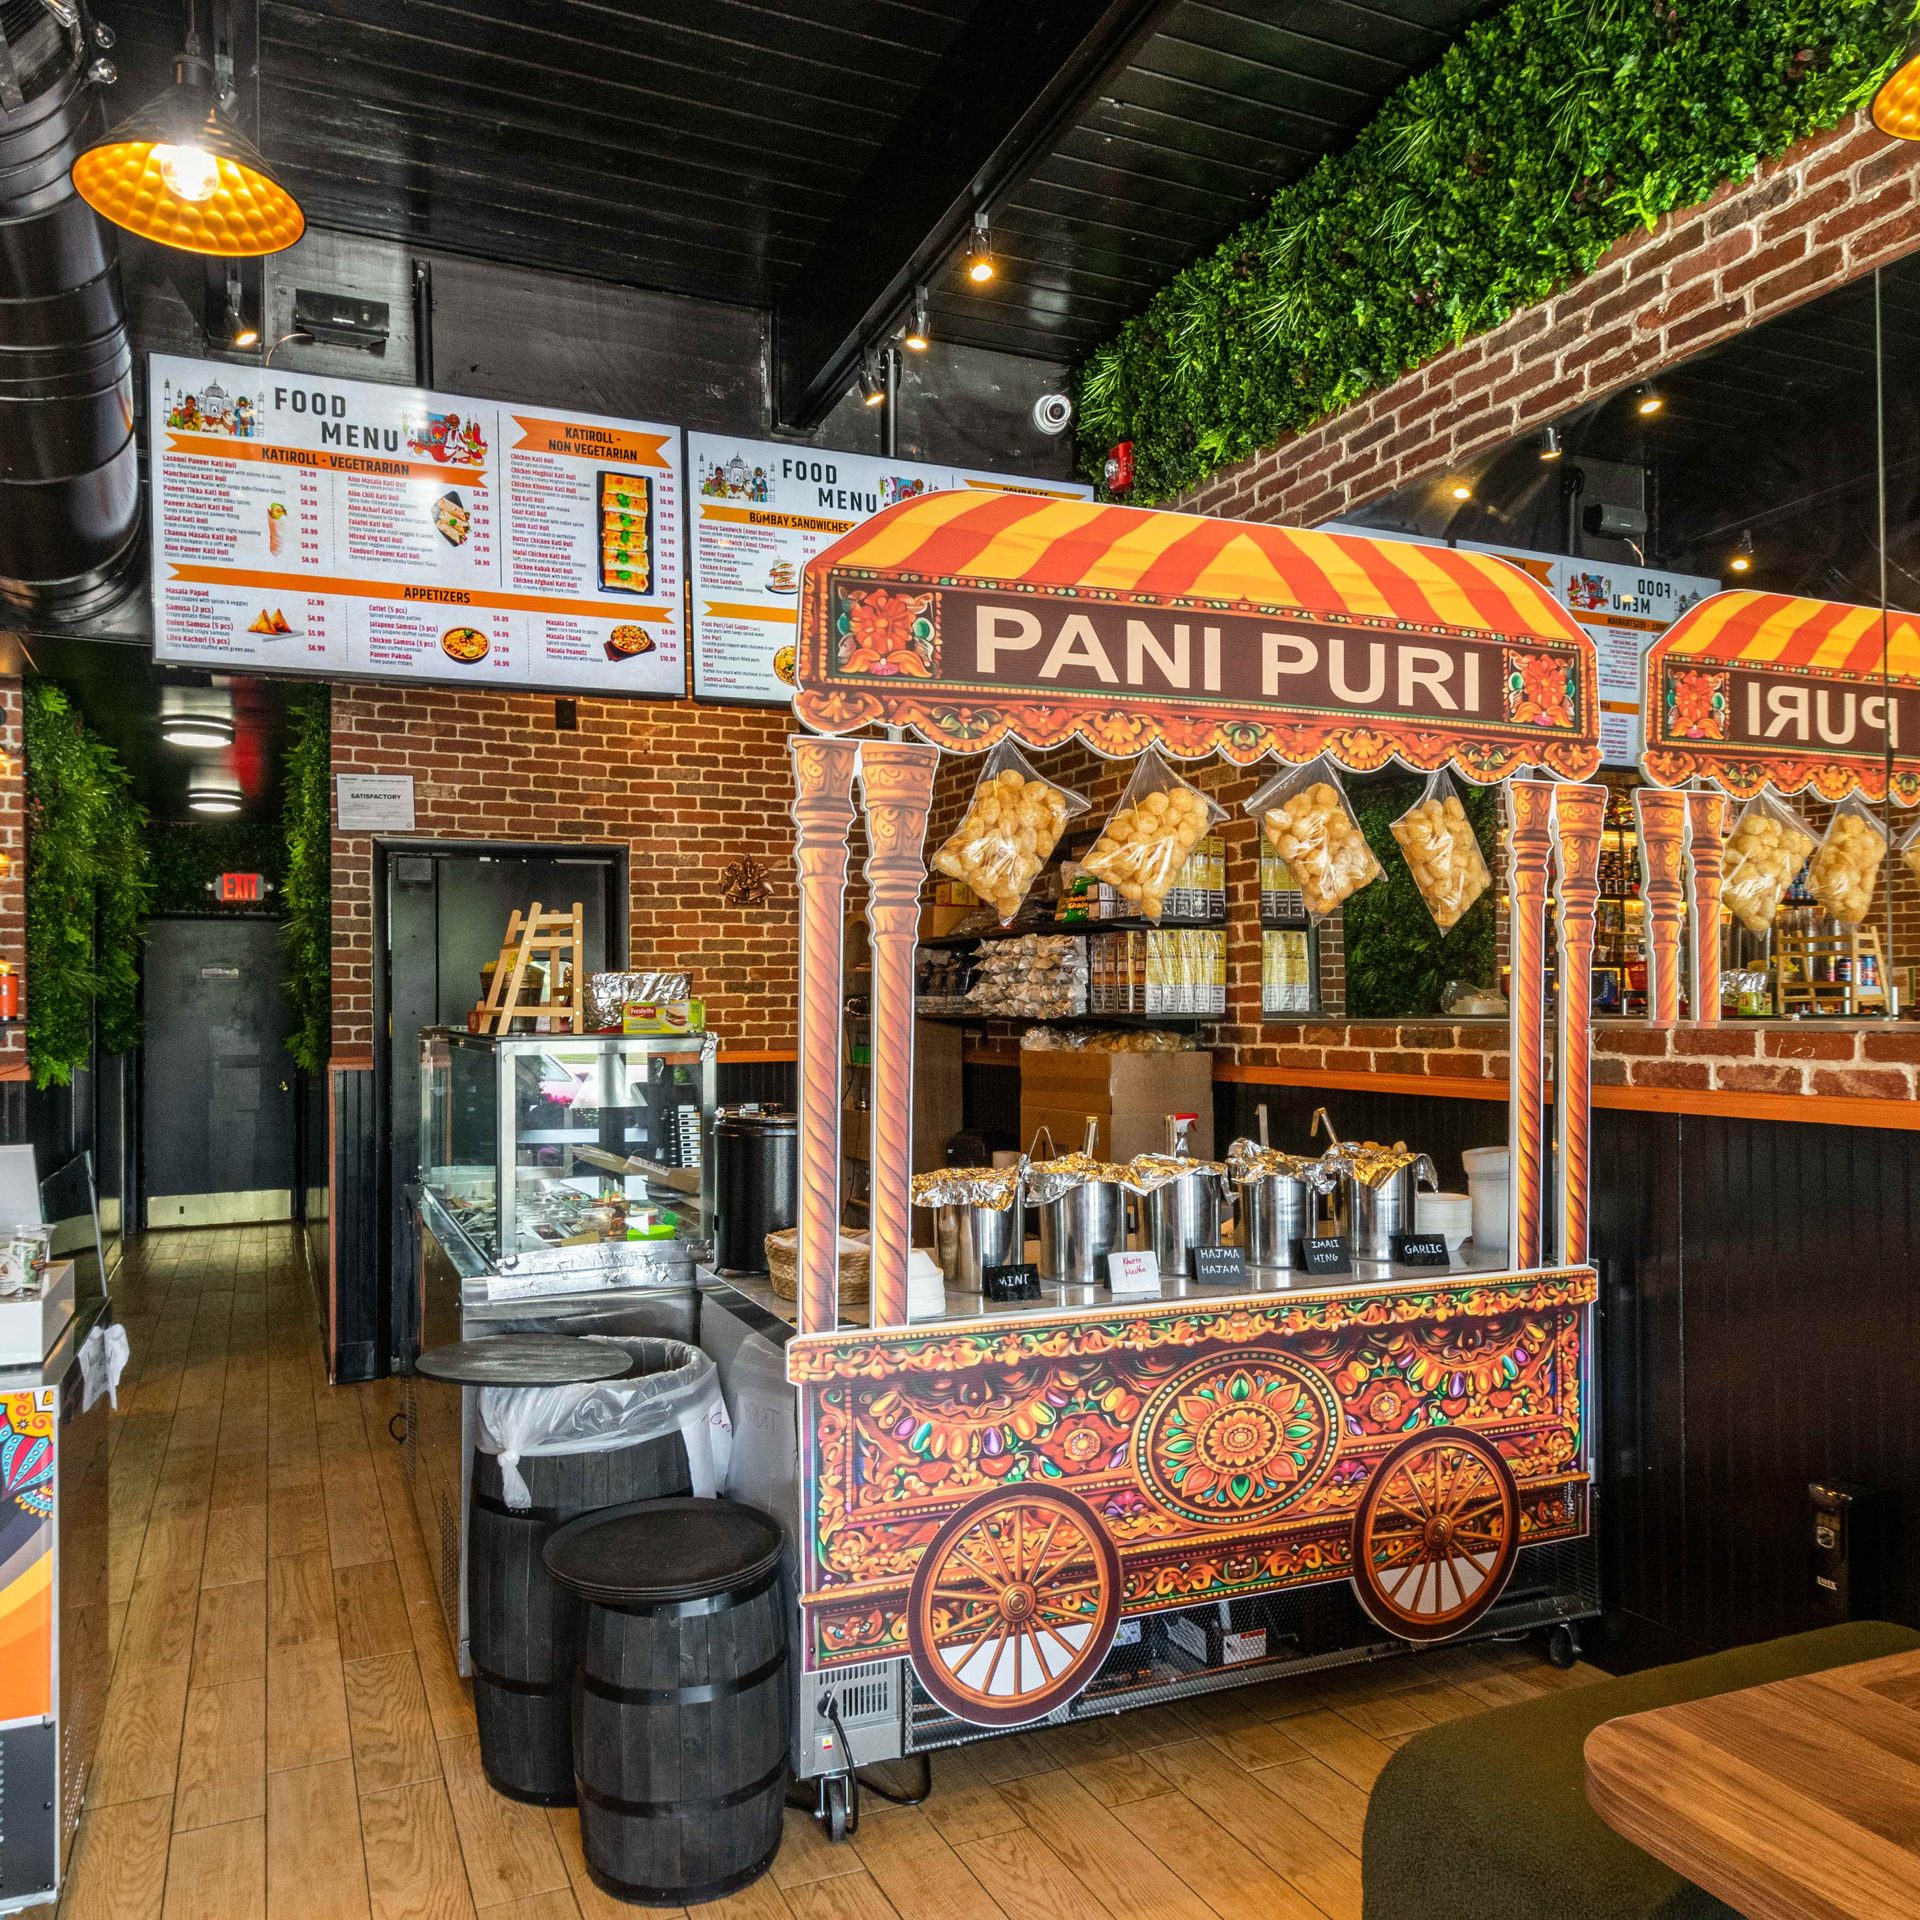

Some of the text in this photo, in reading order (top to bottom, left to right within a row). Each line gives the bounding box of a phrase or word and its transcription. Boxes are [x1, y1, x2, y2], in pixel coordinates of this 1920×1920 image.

[274, 386, 346, 418] FOOD
[321, 420, 398, 452] MENU
[564, 426, 613, 444] KATIROLL
[548, 439, 637, 461] NON VEGETARIAN
[261, 447, 318, 465] KATIROLL
[329, 455, 409, 476] VEGETRARIAN
[782, 458, 837, 484] FOOD
[818, 487, 877, 513] MENU
[748, 511, 848, 533] BOMBAY SANDWICHES
[307, 598, 324, 606] $2.99
[403, 587, 470, 603] APPETIZERS
[191, 604, 199, 613] (2
[199, 606, 214, 614] pcs)
[307, 614, 324, 622] $4.99
[977, 605, 1479, 712] PANI PURI
[223, 873, 257, 899] EXIT
[1200, 1249, 1240, 1259] HAJMA
[1313, 1253, 1339, 1262] HING
[1404, 1243, 1443, 1254] GARLIC
[1201, 1264, 1240, 1274] HAJAM
[999, 1273, 1030, 1287] MINT
